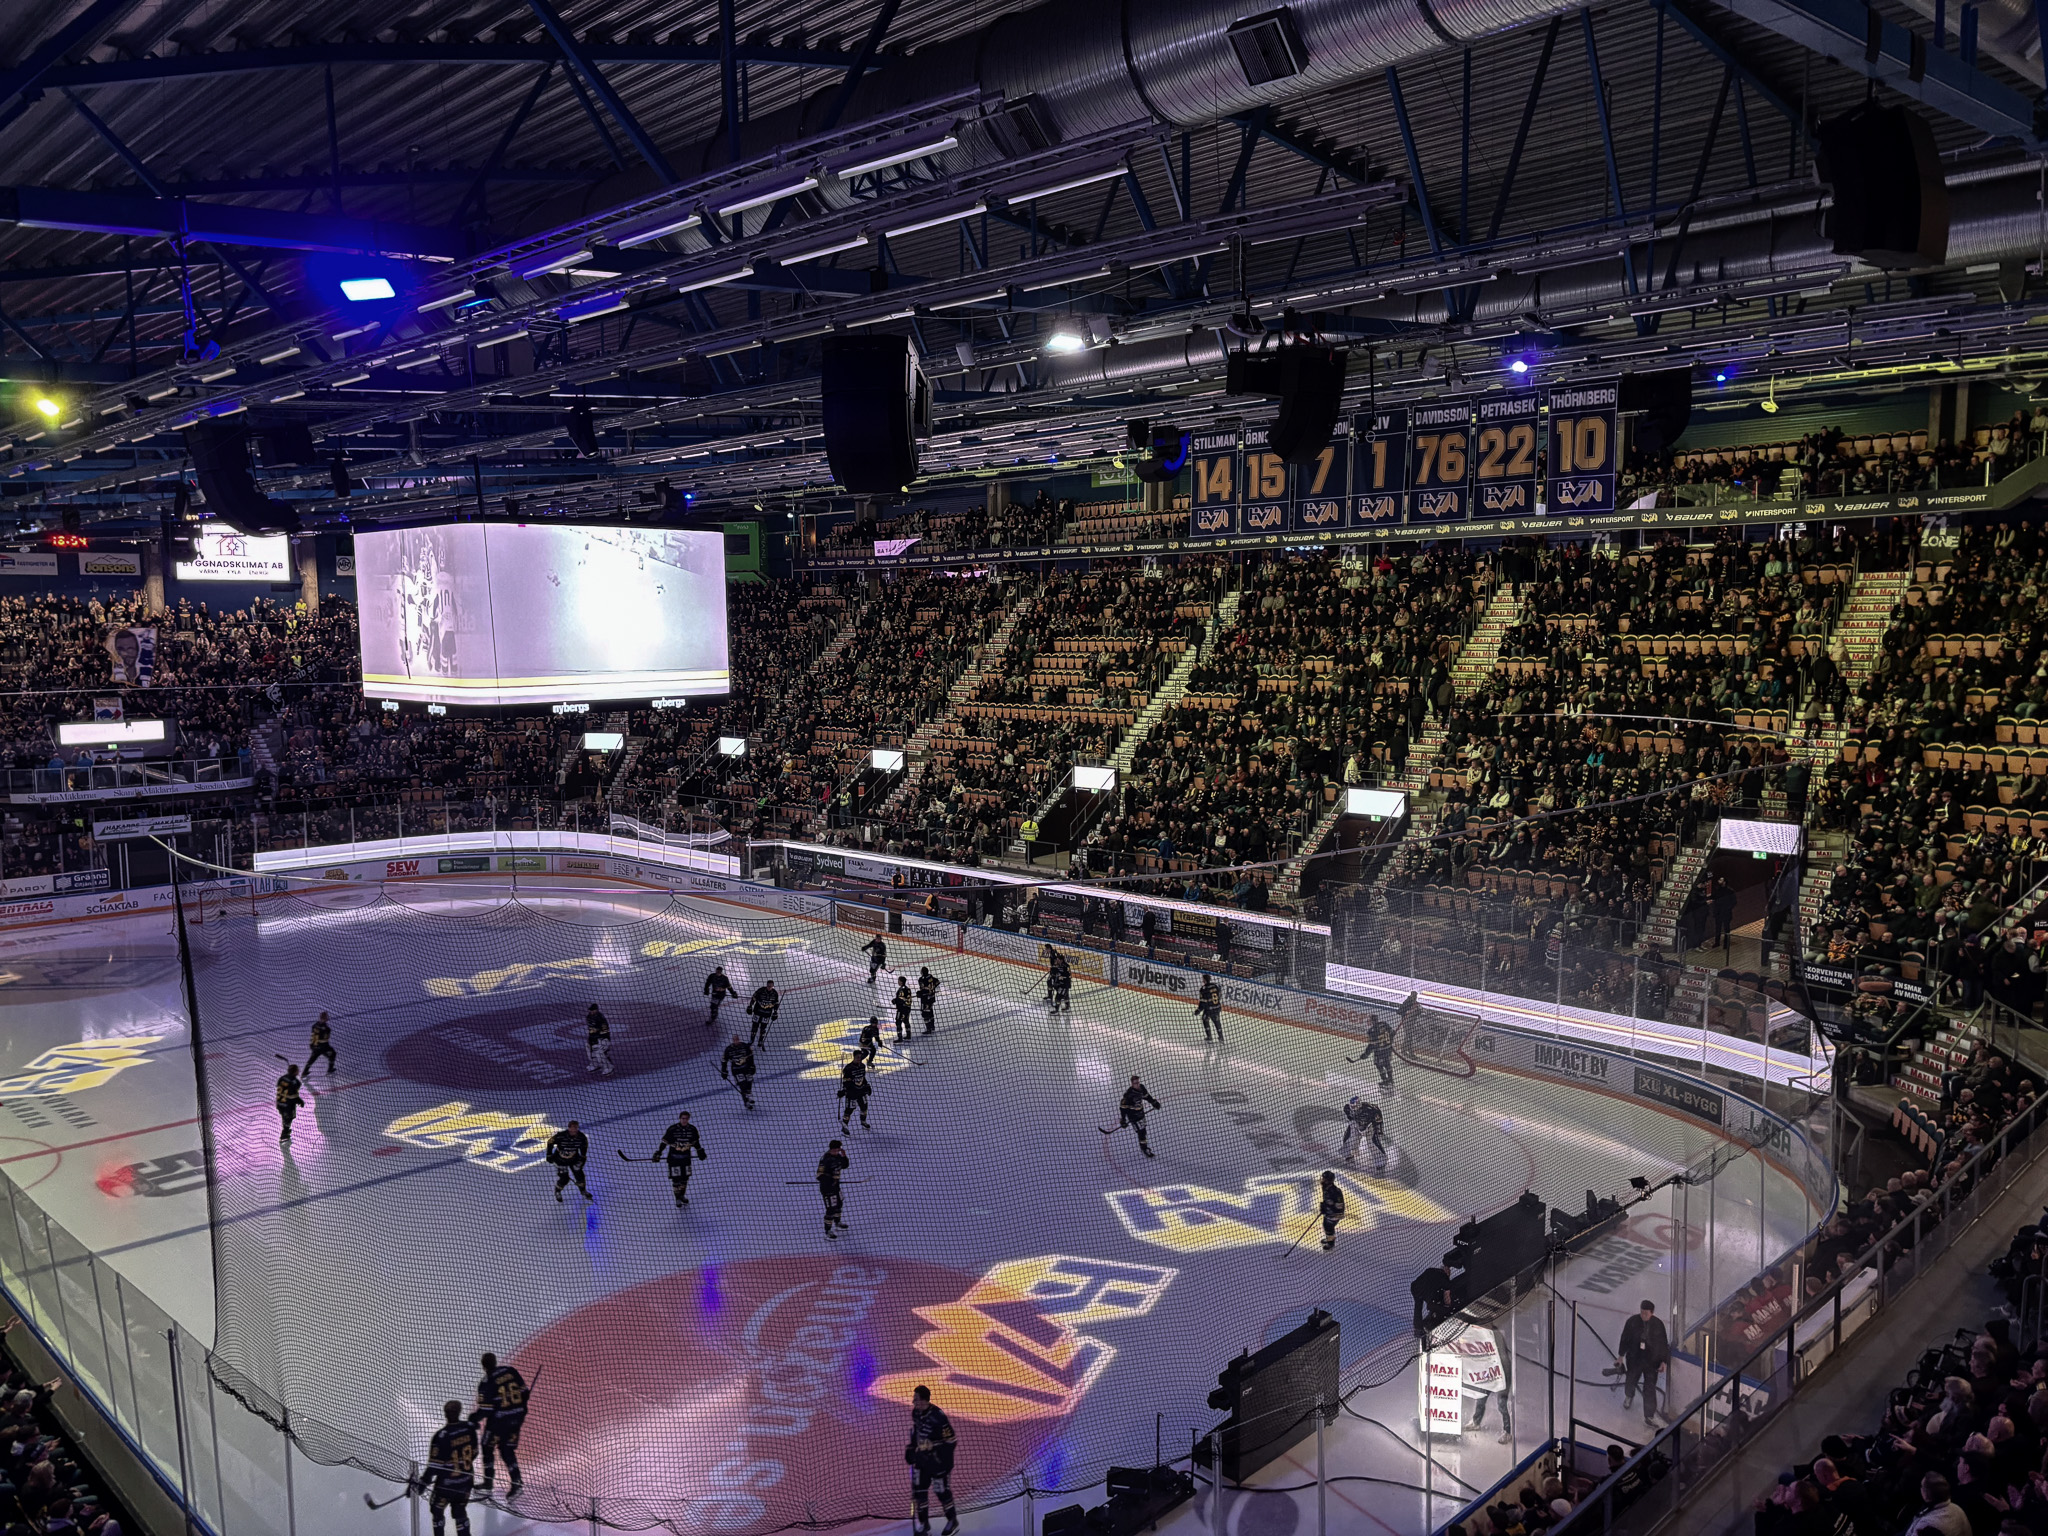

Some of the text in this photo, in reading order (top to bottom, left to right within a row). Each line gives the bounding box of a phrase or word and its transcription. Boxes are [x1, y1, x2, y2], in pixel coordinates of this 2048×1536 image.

[1551, 388, 1615, 409] THÖRNBERG
[1480, 398, 1536, 418] PETRASEK
[1415, 407, 1468, 425] DAVIDSSON
[1194, 433, 1236, 450] STILLMAN
[1556, 416, 1607, 472] 10
[1416, 432, 1466, 484] 76
[1478, 424, 1535, 480] 22
[1371, 440, 1388, 488] 1
[1196, 456, 1233, 503] 14
[1246, 453, 1286, 500] 15
[1557, 479, 1603, 507] HV71
[1932, 494, 1988, 506] INTERSPORT
[1751, 507, 1798, 518] INTERSPORT
[1841, 501, 1890, 512] BAUER
[1528, 520, 1563, 528] BAUER
[1595, 515, 1635, 524] INTERSPORT
[1672, 513, 1714, 521] BAUER
[1401, 529, 1431, 537] BAUER
[1460, 523, 1494, 532] INTERSPORT
[1924, 516, 1949, 539] 71
[1921, 535, 1960, 549] ZONE
[85, 561, 137, 574] Jonsons
[271, 561, 284, 569] AB
[1863, 572, 1884, 580] MAXI
[553, 702, 590, 714] nybergs
[652, 697, 687, 709] nybergs
[387, 860, 420, 873] SEW
[816, 854, 843, 869] Sydved
[904, 921, 948, 942] Husqvarna
[1129, 963, 1186, 991] nybergs
[1834, 969, 1853, 981] FRÅN
[1904, 983, 1923, 994] SMAK
[1225, 986, 1282, 1010] RESINEX
[1535, 1043, 1609, 1079] IMPACT BY
[1911, 1069, 1931, 1084] MAXI
[1895, 1077, 1939, 1101] MAXI MAXI
[1662, 1083, 1719, 1116] XL-BYGG
[1429, 1363, 1459, 1377] MAXI
[1429, 1386, 1459, 1398] MAXI
[1429, 1408, 1459, 1420] MAXI
